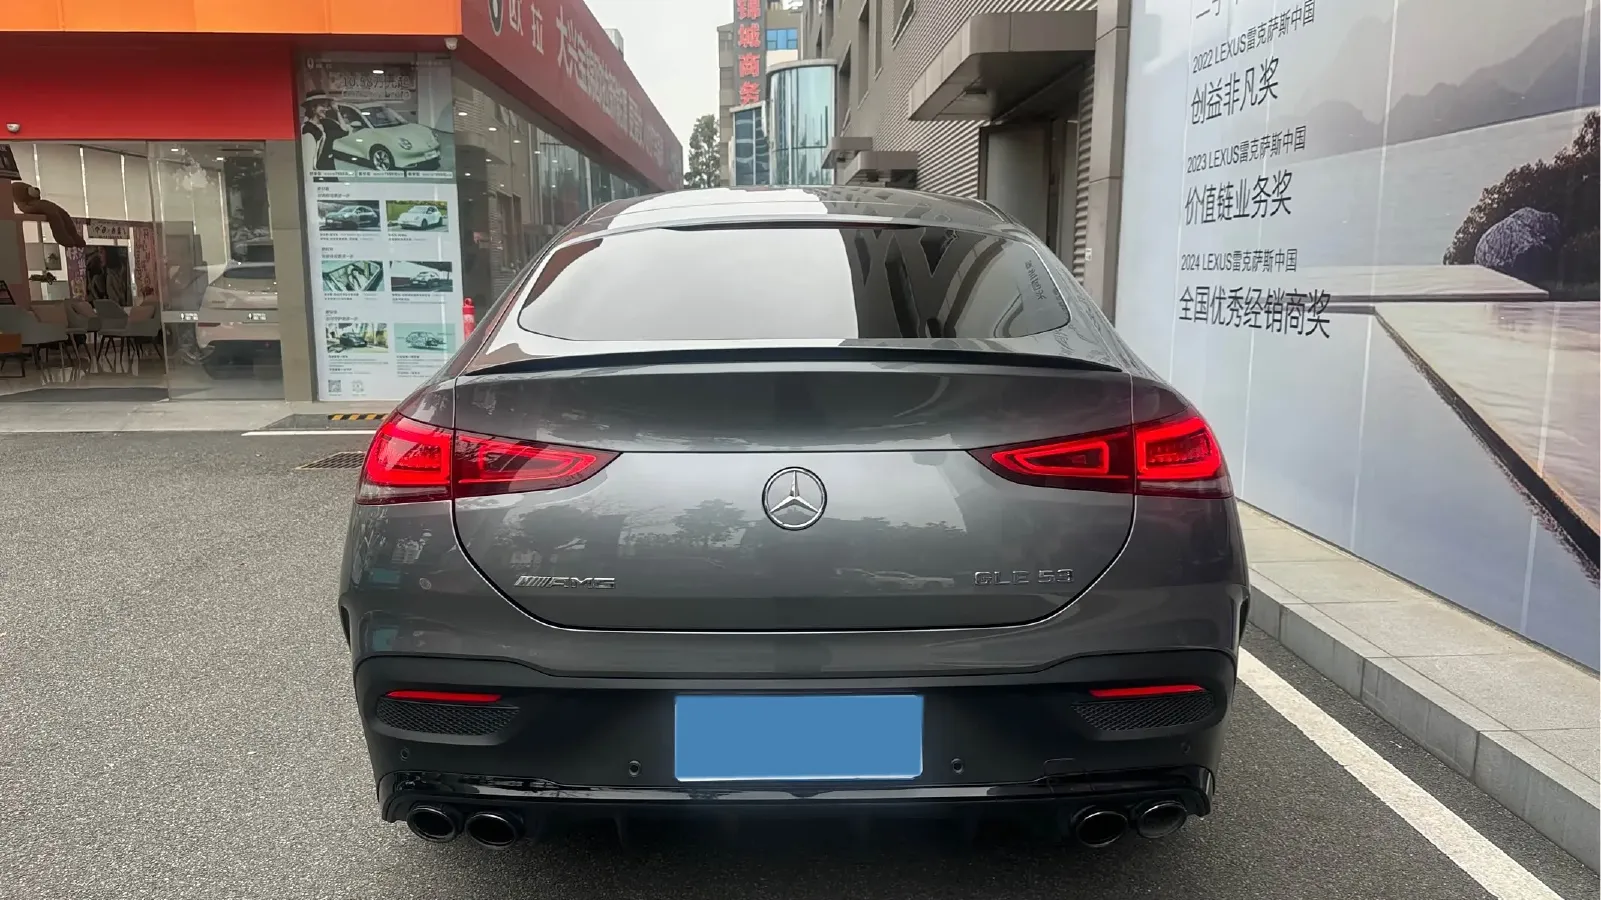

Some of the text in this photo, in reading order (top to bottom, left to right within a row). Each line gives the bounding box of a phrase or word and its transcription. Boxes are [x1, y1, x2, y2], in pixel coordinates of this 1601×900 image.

[1192, 49, 1213, 74] 2022
[1214, 0, 1317, 66] LEXUS雷克萨斯中国
[1190, 55, 1280, 125] 创益非凡奖
[1187, 125, 1307, 174] 2023 LEXUS雷克萨斯中国
[1185, 169, 1292, 226] 价值链业务奖
[1181, 248, 1298, 273] 2024 LEXUS雷克萨斯中国
[1178, 284, 1331, 339] 全国优秀经销商奖
[974, 568, 1075, 585] GLE 53
